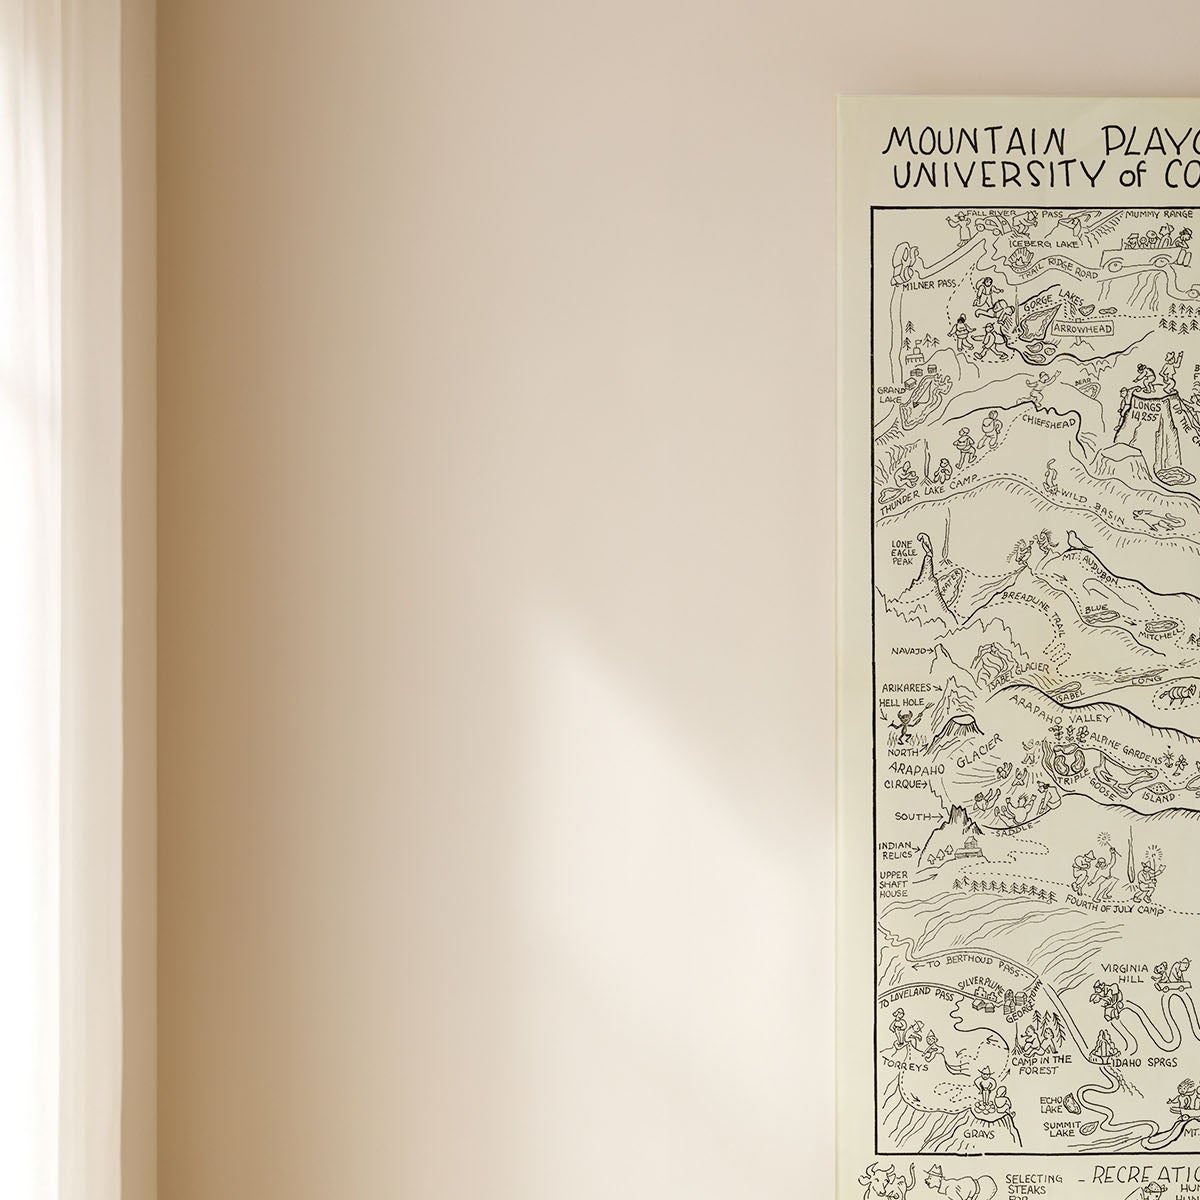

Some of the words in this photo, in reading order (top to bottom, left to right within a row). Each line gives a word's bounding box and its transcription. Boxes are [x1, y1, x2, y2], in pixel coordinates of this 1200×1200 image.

[882, 126, 1065, 155] MOUNTAIN
[894, 159, 1105, 188] UNIVERSITY
[1120, 160, 1146, 187] of
[1164, 210, 1193, 218] RANGE
[1009, 240, 1052, 248] ICEBERG
[1019, 264, 1044, 280] TRAIL
[1048, 258, 1073, 272] RIDGE
[1075, 266, 1099, 279] ROAD
[903, 280, 934, 291] MILNER
[937, 279, 957, 288] PASS
[1024, 295, 1053, 312] GORGE
[1059, 289, 1084, 306] LAKES
[1054, 324, 1111, 333] ARROWHEAD
[877, 386, 906, 394] GRAND
[880, 396, 902, 404] LAKE
[1133, 401, 1161, 412] LONGS
[1022, 414, 1076, 429] CHIEFSHEAD
[1131, 412, 1159, 422] 14255
[924, 486, 945, 496] LAKE
[950, 474, 978, 490] CAMP
[1061, 490, 1088, 503] WILD
[891, 540, 913, 548] LONE
[891, 549, 918, 557] EAGLE
[1001, 592, 1049, 613] BREADLINE
[1085, 604, 1108, 614] BLUE
[1138, 628, 1183, 641] MITCHELL
[891, 647, 926, 655] NAVAJO
[882, 683, 931, 693] ARIKAREES
[879, 699, 900, 707] HELL
[902, 698, 925, 707] HOLE
[1009, 694, 1063, 725] ARAPAHO
[1069, 714, 1112, 723] VALLEY
[887, 749, 919, 757] NORTH
[956, 733, 1003, 769] GLACIER
[888, 761, 945, 775] ARAPAHO
[1142, 791, 1175, 803] ISLAND
[895, 812, 931, 820] SOUTH
[878, 841, 912, 850] INDIAN
[882, 851, 913, 859] RELICS
[880, 871, 908, 879] UPPER
[879, 880, 909, 888] SHAFT
[880, 889, 908, 898] HOUSE
[1065, 893, 1099, 912] FOURTH
[1137, 906, 1165, 916] CAMP
[946, 954, 993, 965] BERTHOUD
[1101, 964, 1149, 973] VIRGINIA
[1118, 975, 1144, 983] HILL
[935, 989, 954, 1001] PASS
[882, 1058, 929, 1072] TORREYS
[1012, 1057, 1038, 1066] CAMP
[1052, 1055, 1072, 1063] THE
[1112, 1058, 1141, 1068] IDAHO
[1147, 1057, 1178, 1067] SPRGS
[1019, 1066, 1059, 1075] FOREST
[1041, 1105, 1063, 1114] LAKE
[1043, 1121, 1080, 1130] SUMMIT
[1049, 1129, 1075, 1137] LAKE
[1005, 1174, 1063, 1184] SELECTING
[1008, 1185, 1046, 1194] STEAKS
